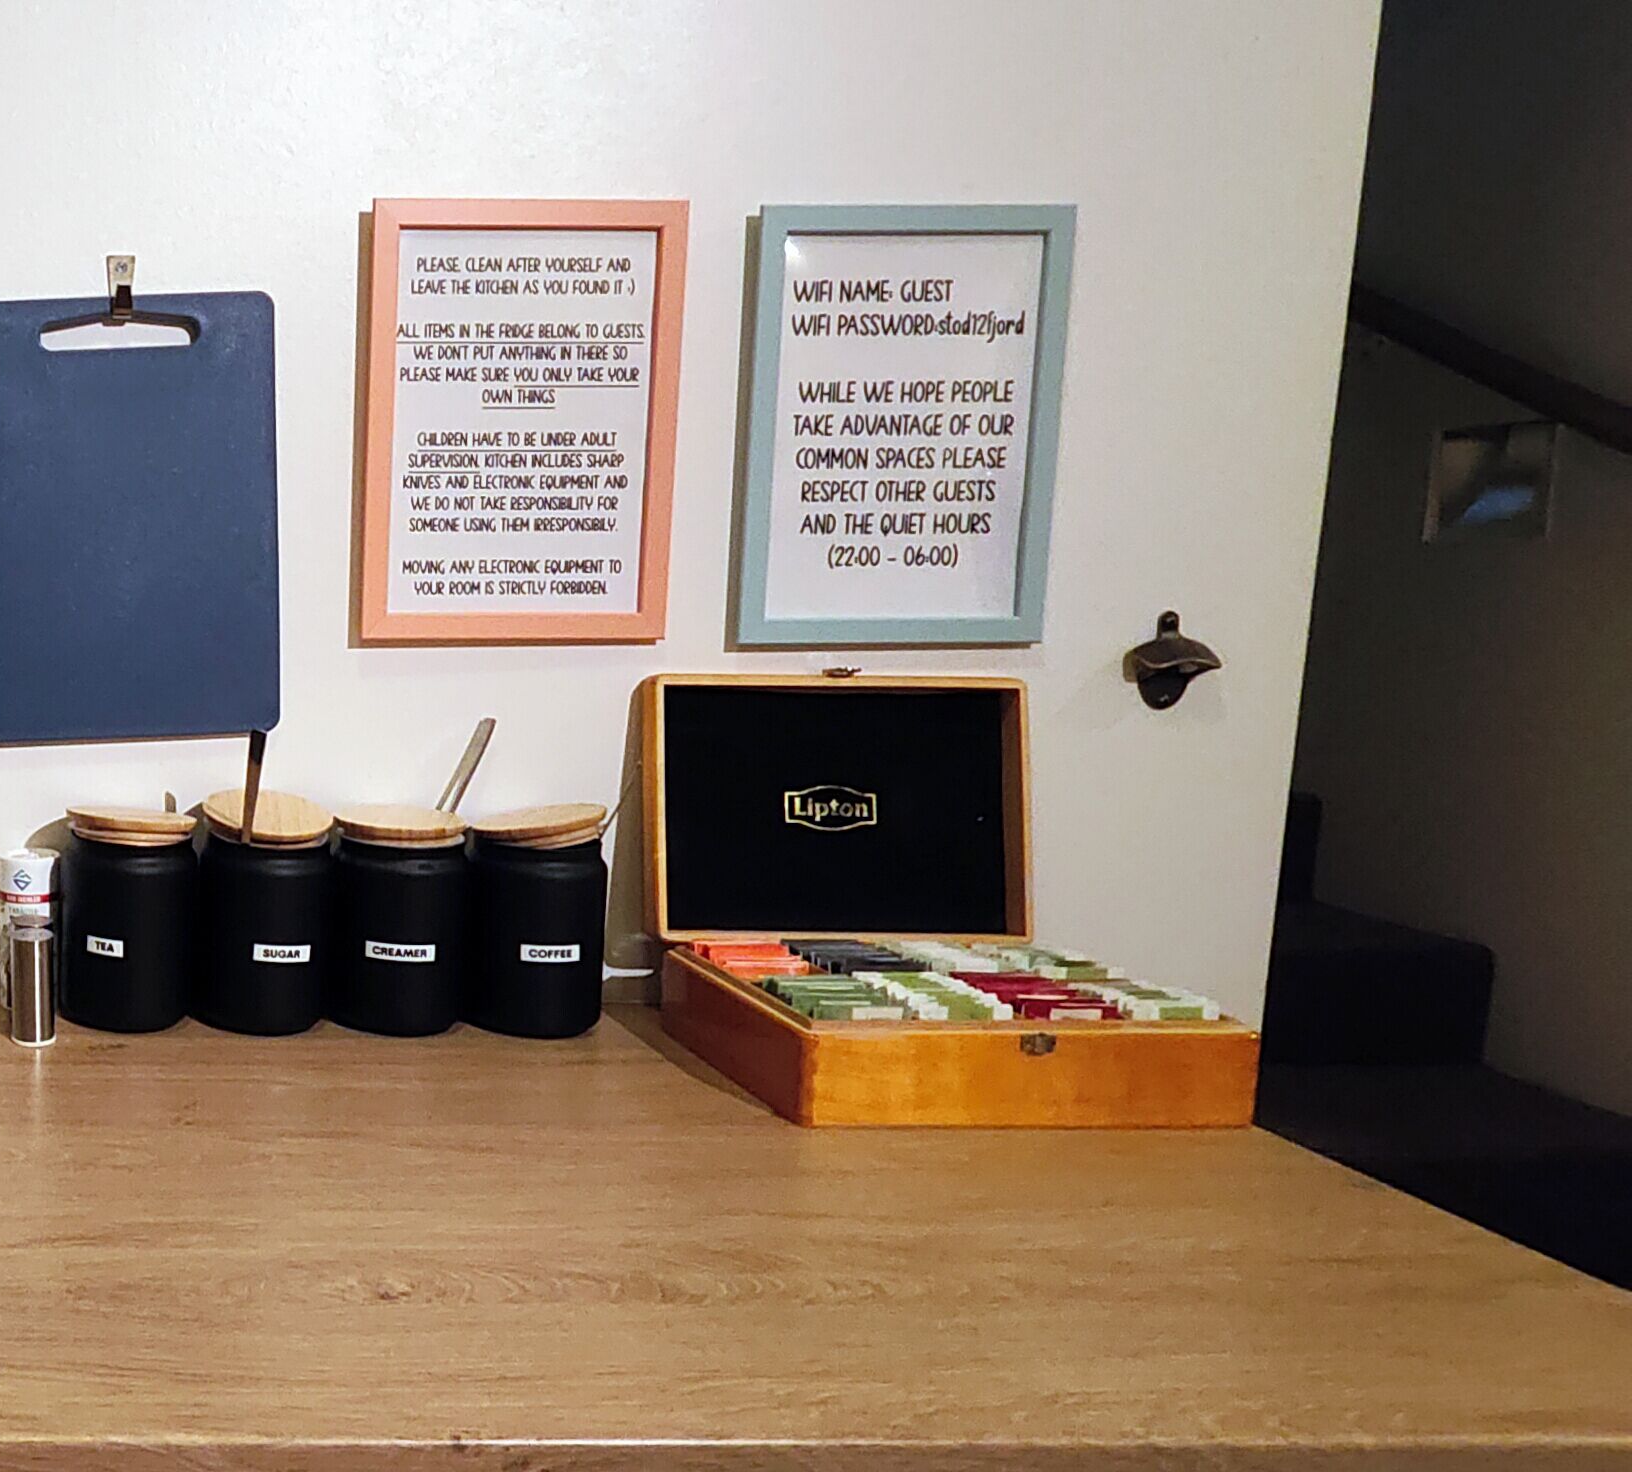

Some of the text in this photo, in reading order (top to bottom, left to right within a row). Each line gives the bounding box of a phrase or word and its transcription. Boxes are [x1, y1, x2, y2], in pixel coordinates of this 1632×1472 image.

[465, 257, 502, 273] CLEAN
[506, 257, 541, 273] AFTER
[545, 257, 603, 273] YOURSELF
[606, 257, 631, 273] AND
[411, 279, 447, 295] LEAVE
[451, 279, 471, 295] THE
[475, 279, 518, 295] KITCHEN
[523, 279, 539, 295] AS
[543, 280, 569, 295] YOU
[572, 279, 610, 295] FOUND
[614, 279, 623, 295] IT
[794, 279, 954, 303] WIFI NAME: GUEST
[397, 323, 420, 338] ALL
[424, 323, 455, 338] ITEMS
[459, 324, 470, 338] IN
[475, 323, 495, 339] THE
[499, 323, 534, 339] FRIDGE
[538, 323, 580, 339] BELONG
[585, 323, 598, 338] TO
[792, 314, 831, 336] WIFI
[414, 345, 433, 360] WE
[473, 345, 495, 360] PUT
[499, 345, 556, 361] ANYTHING
[560, 346, 572, 360] IN
[576, 345, 608, 361] THERE
[613, 345, 628, 360] SO
[400, 367, 640, 382] PLEASE MAKE SURE YOU ONLY TAKE YOUR
[482, 389, 555, 404] OWN THINGS
[799, 380, 1015, 404] WHILE WE HOPE PEOPLE
[793, 413, 1014, 437] TAKE ADVANTAGE OF OUR
[417, 431, 617, 447] CHILDREN HAVE TO BE UNDER ADULT
[484, 453, 527, 468] KITCHEN
[531, 453, 583, 468] INCLUDES
[587, 453, 624, 468] SHARP
[796, 446, 1007, 470] COMMON SPACES PLEASE
[403, 474, 628, 491] KNIVES AND ELECTRONIC EQUIPMENT AND
[801, 479, 997, 503] RESPECT OTHER GUESTS
[411, 496, 619, 511] WE DO NOT TAKE RESPONSIBILITY FOR
[409, 517, 460, 532] SOMEONE
[464, 517, 496, 532] USING
[501, 517, 530, 532] THEM
[800, 513, 836, 535] AND
[844, 513, 874, 535] THE
[933, 512, 992, 534] HOURS
[828, 544, 880, 569] (22:00
[903, 543, 958, 568] 06:00)
[402, 559, 622, 575] MOVING ANY ELECTRONIC EQUIPMENT TO
[414, 581, 445, 595] YOUR
[449, 581, 481, 595] ROOM
[485, 580, 494, 595] IS
[499, 580, 546, 595] STRICTLY
[794, 797, 869, 822] Lipton
[95, 940, 114, 953] TEA
[263, 948, 301, 959] SUGAR
[372, 945, 427, 958] CREAMER
[528, 948, 573, 959] COFFEE
